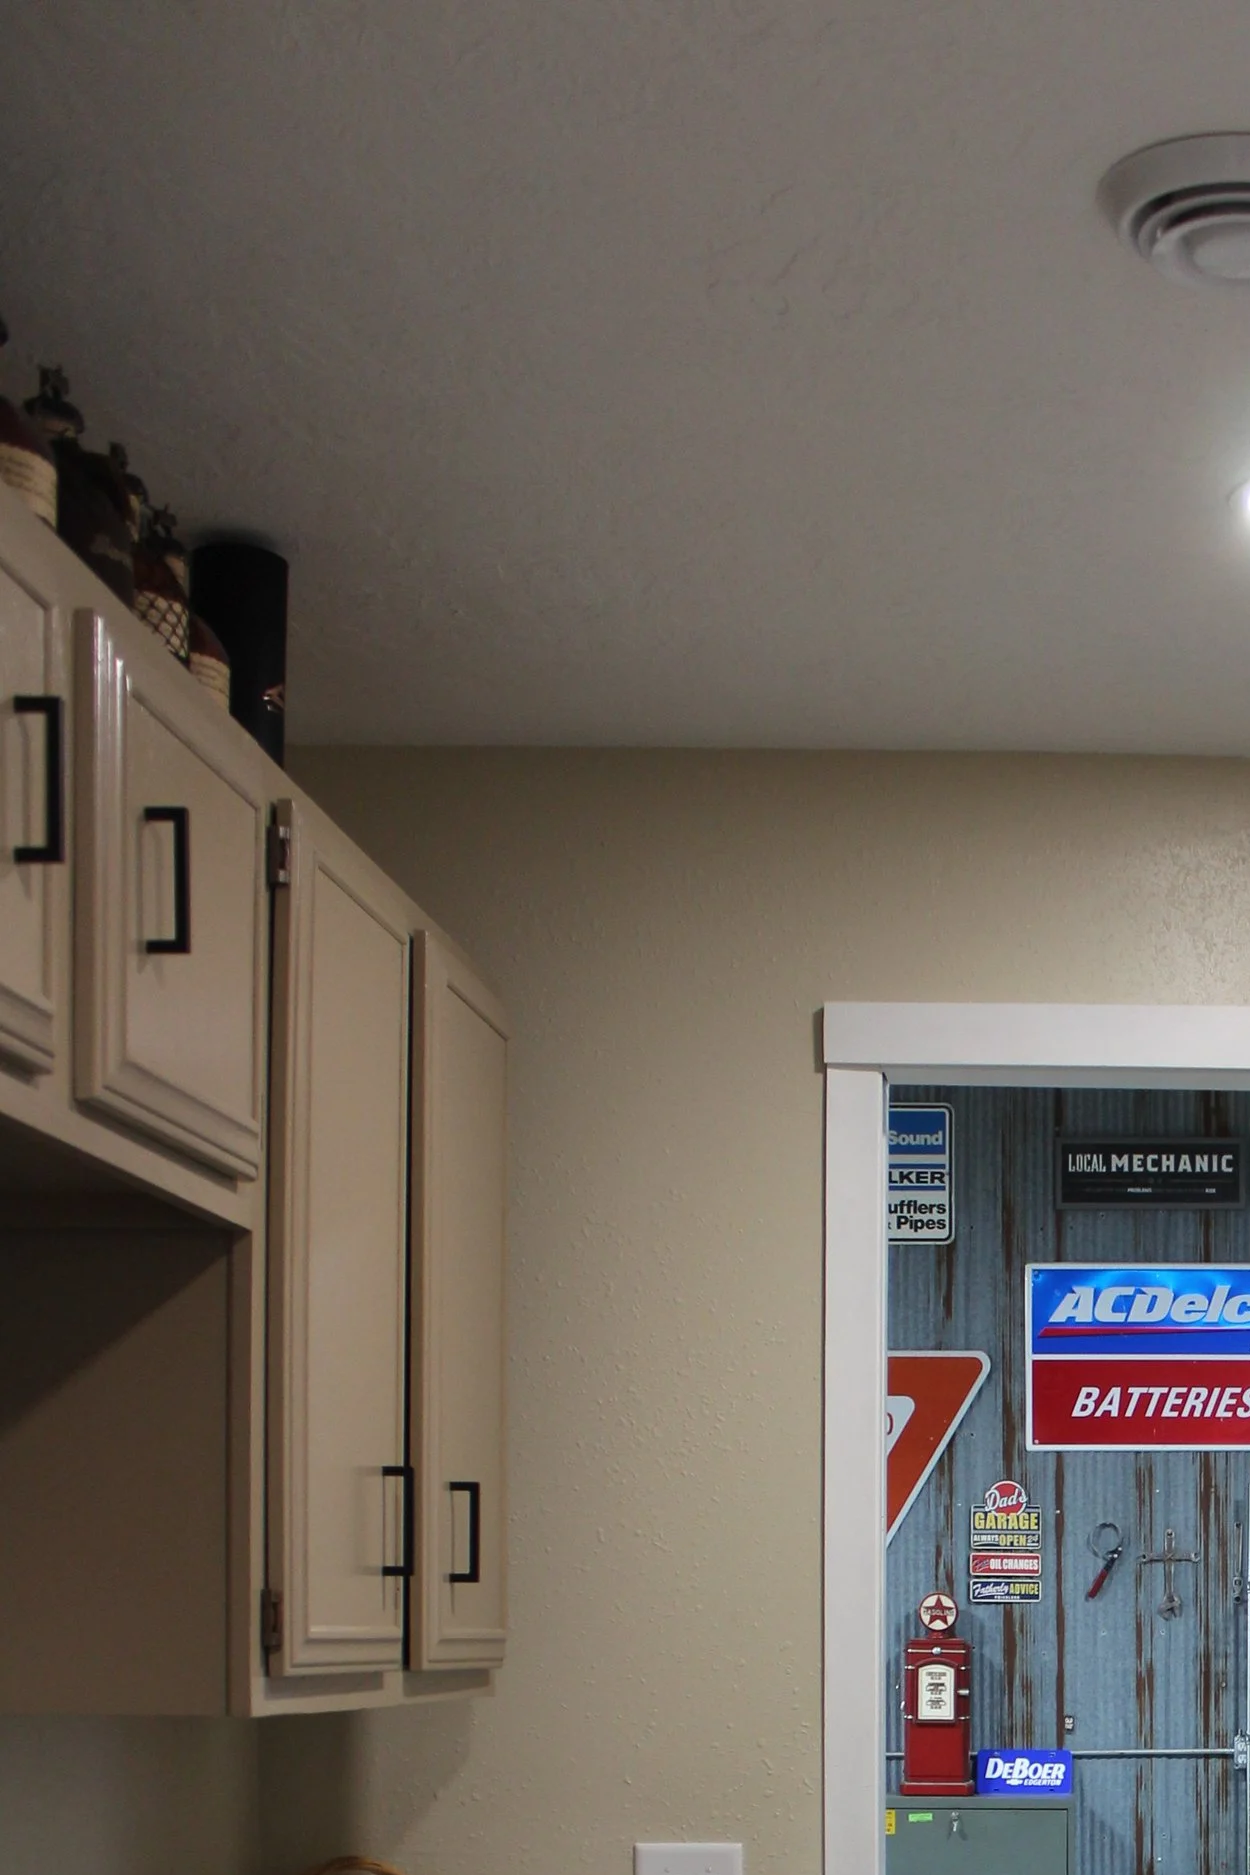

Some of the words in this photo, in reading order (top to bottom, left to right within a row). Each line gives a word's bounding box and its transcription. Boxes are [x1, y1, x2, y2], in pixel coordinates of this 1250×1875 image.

[888, 1130, 943, 1146] Sound
[1068, 1153, 1107, 1173] LOCAL
[1110, 1153, 1234, 1173] MECHANIC
[896, 1215, 947, 1232] Pipes
[974, 1512, 1039, 1530] GARAGE
[973, 1534, 999, 1542] ALWAYS
[999, 1534, 1027, 1546] OPEN
[989, 1558, 1002, 1570] OIL
[1002, 1558, 1039, 1570] CHANGES
[972, 1582, 1009, 1597] Fatherly
[1009, 1583, 1039, 1595] ADVICE
[1023, 1779, 1062, 1787] EDGERTON
